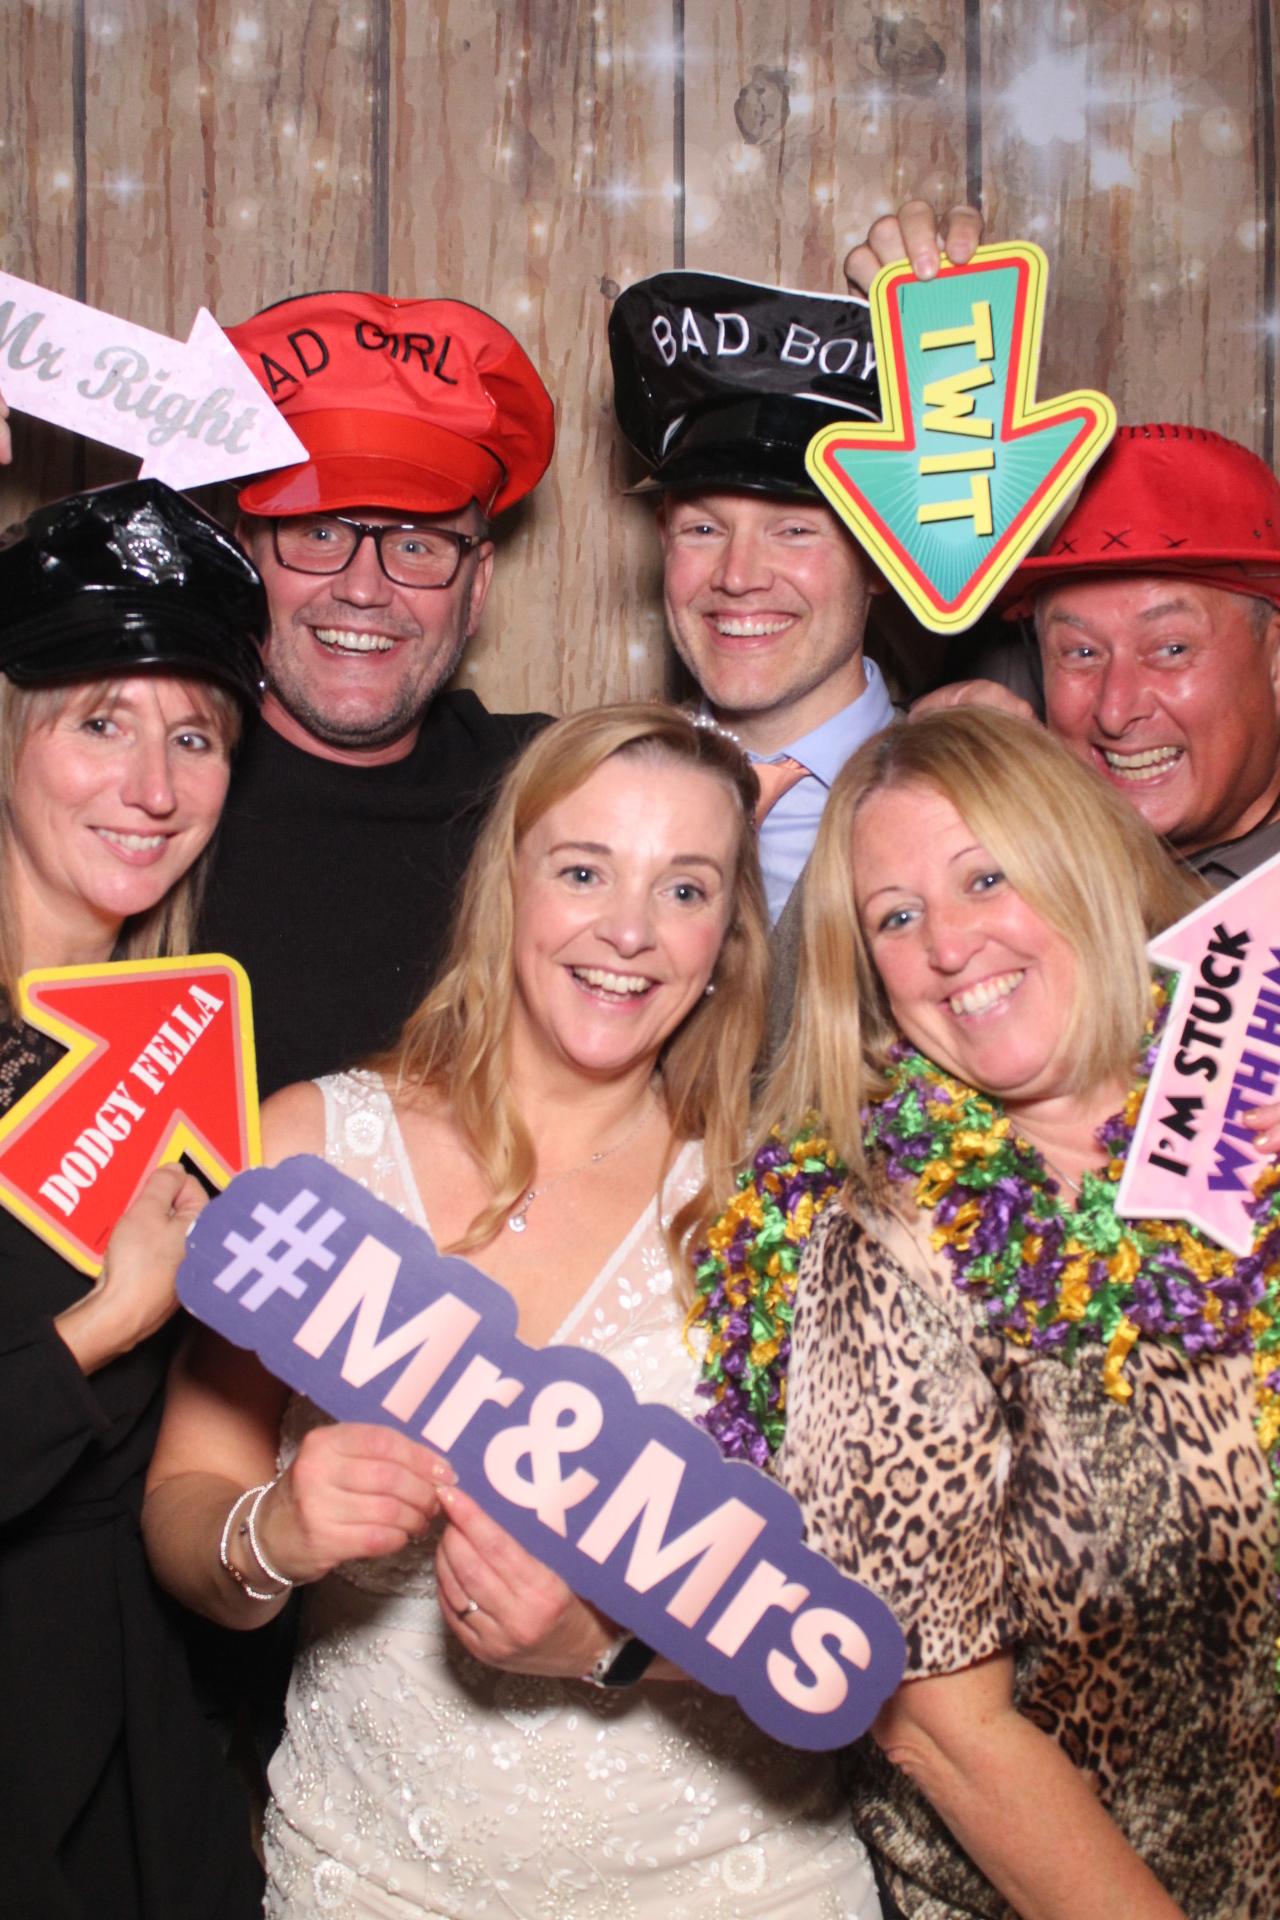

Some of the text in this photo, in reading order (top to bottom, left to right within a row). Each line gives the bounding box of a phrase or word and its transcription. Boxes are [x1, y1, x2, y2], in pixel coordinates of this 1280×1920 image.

[77, 345, 263, 455] Right
[259, 320, 458, 395] AD GIRL
[651, 307, 877, 380] BAD BOY
[917, 301, 996, 537] TWIT
[38, 984, 225, 1217] DODGY FELLA
[1148, 923, 1252, 1177] I'M STUCK
[1207, 1049, 1280, 1191] WITH
[212, 1188, 872, 1714] #Mr&Mrs
